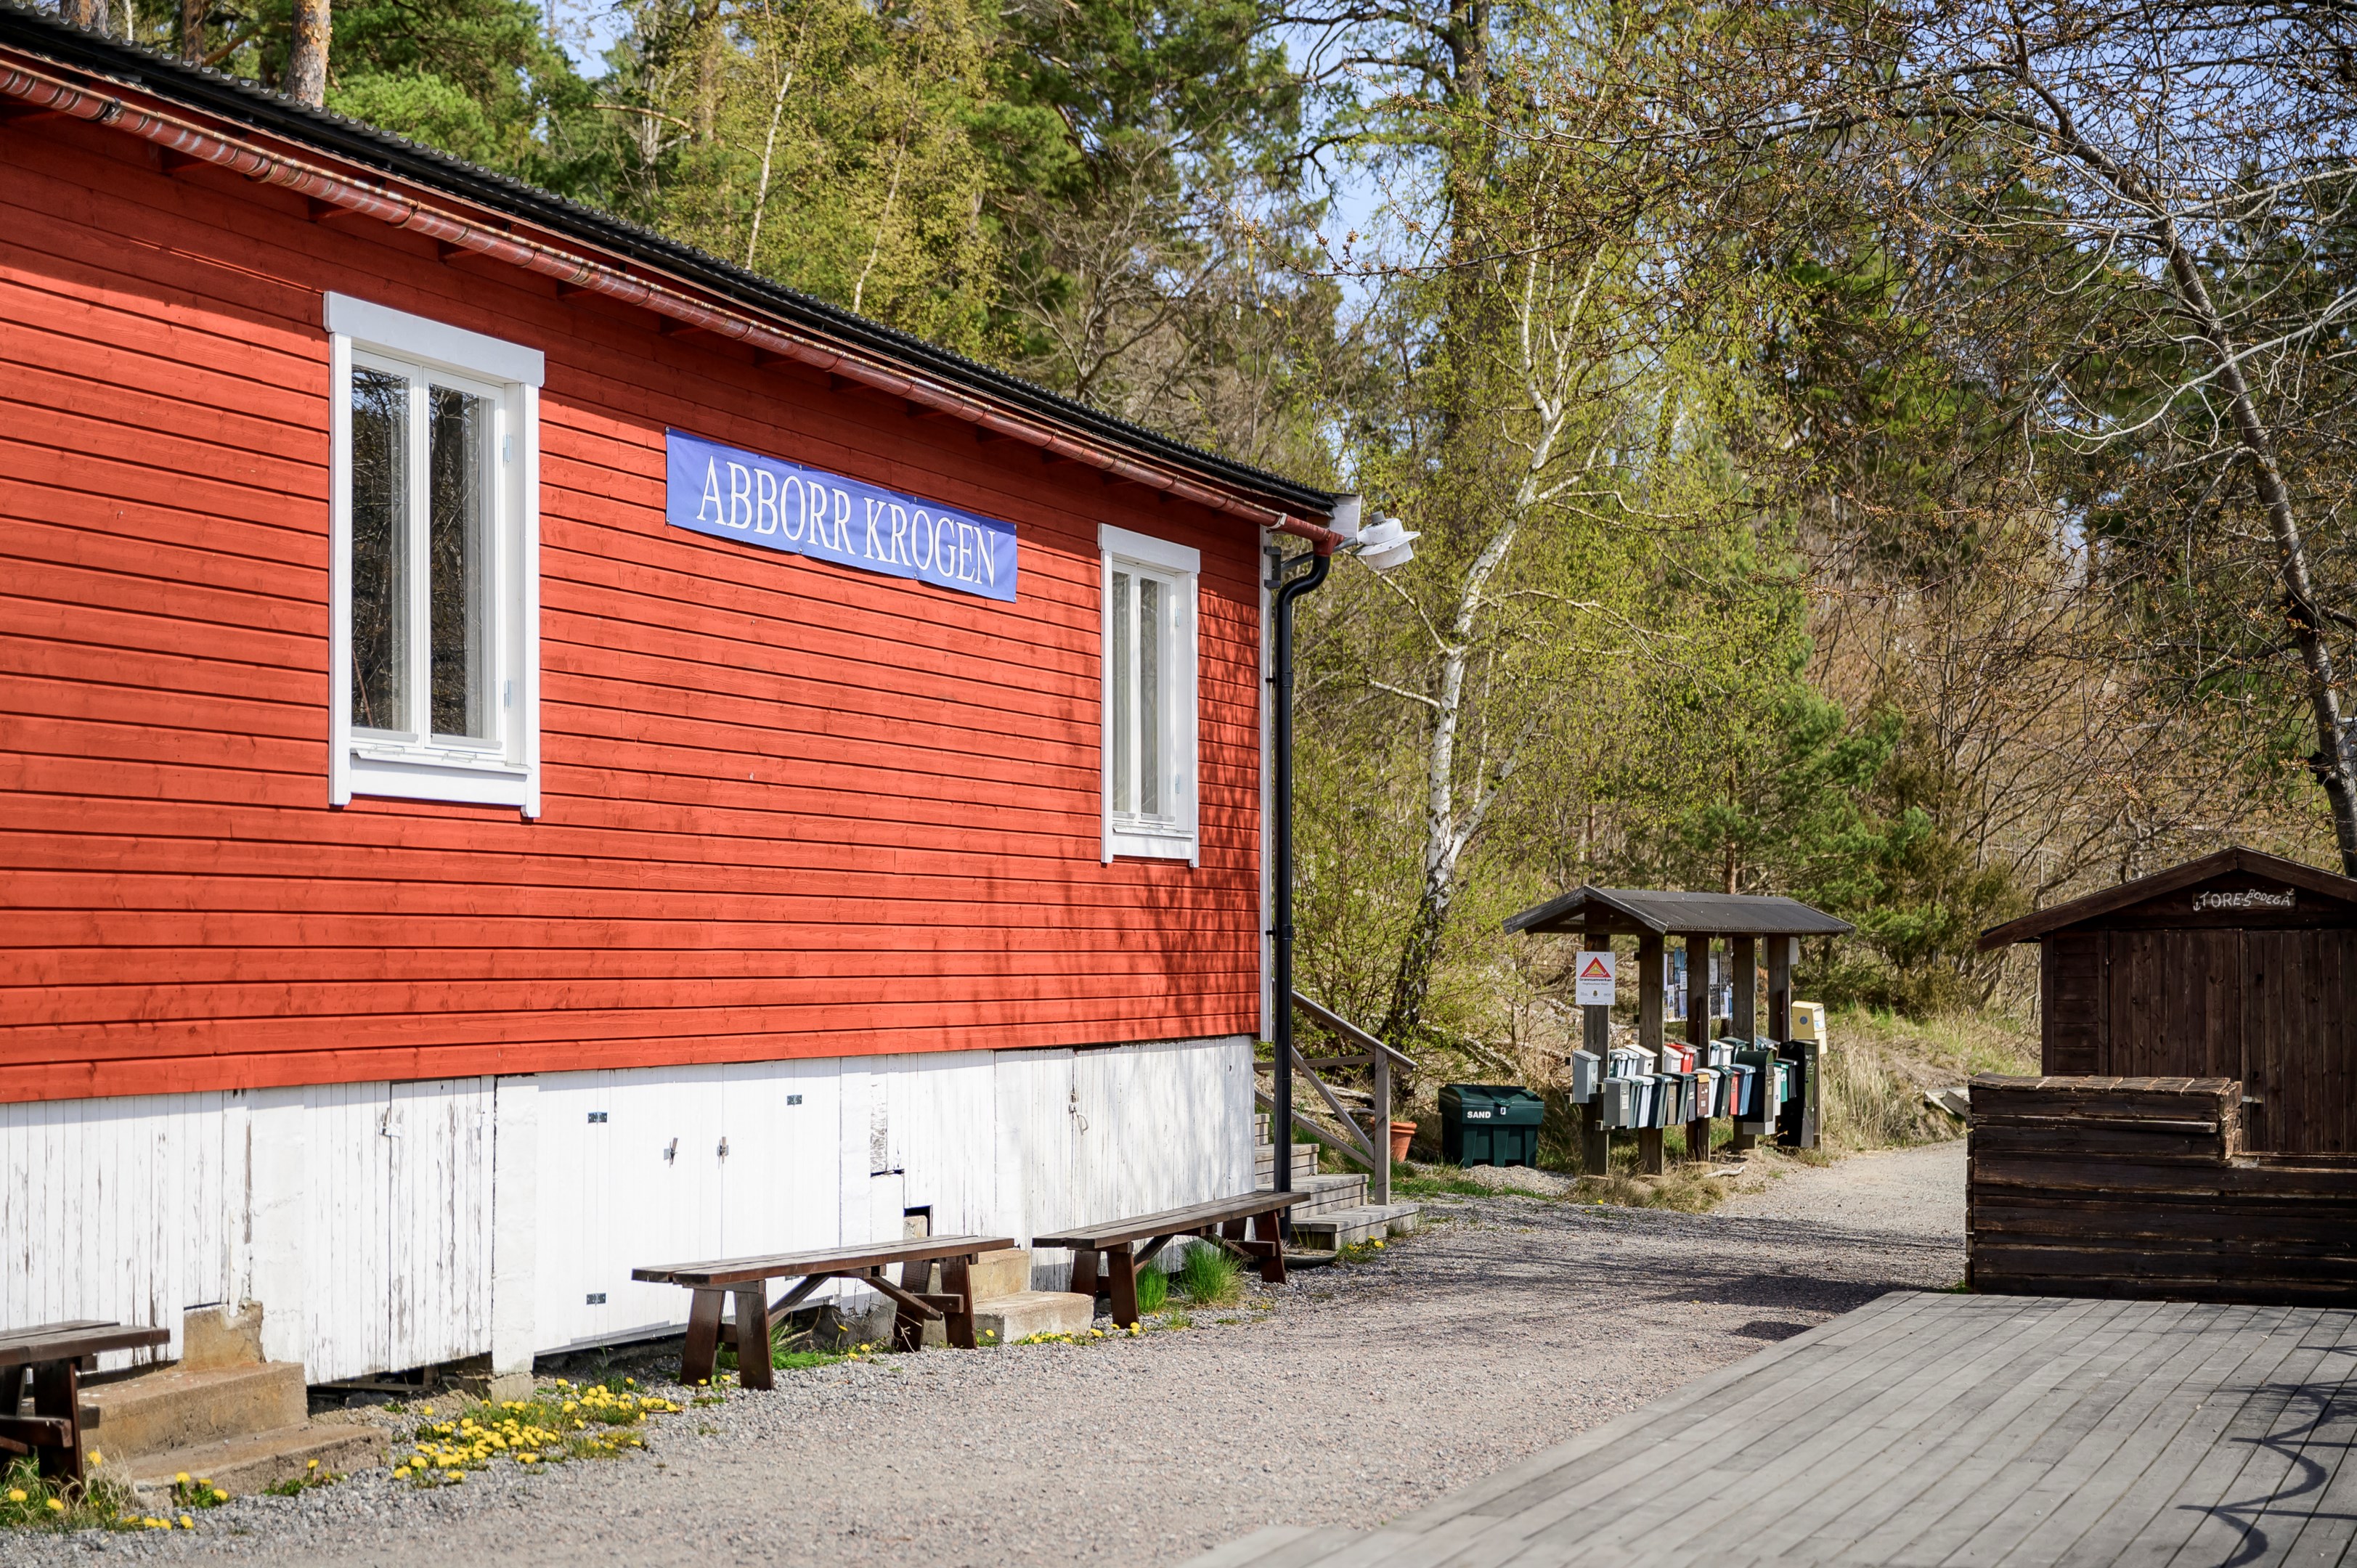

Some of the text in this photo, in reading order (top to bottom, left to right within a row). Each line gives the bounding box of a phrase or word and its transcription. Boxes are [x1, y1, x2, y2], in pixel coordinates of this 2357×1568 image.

[696, 455, 996, 588] ABBORR KROGEN
[2247, 889, 2290, 906] BODEGA
